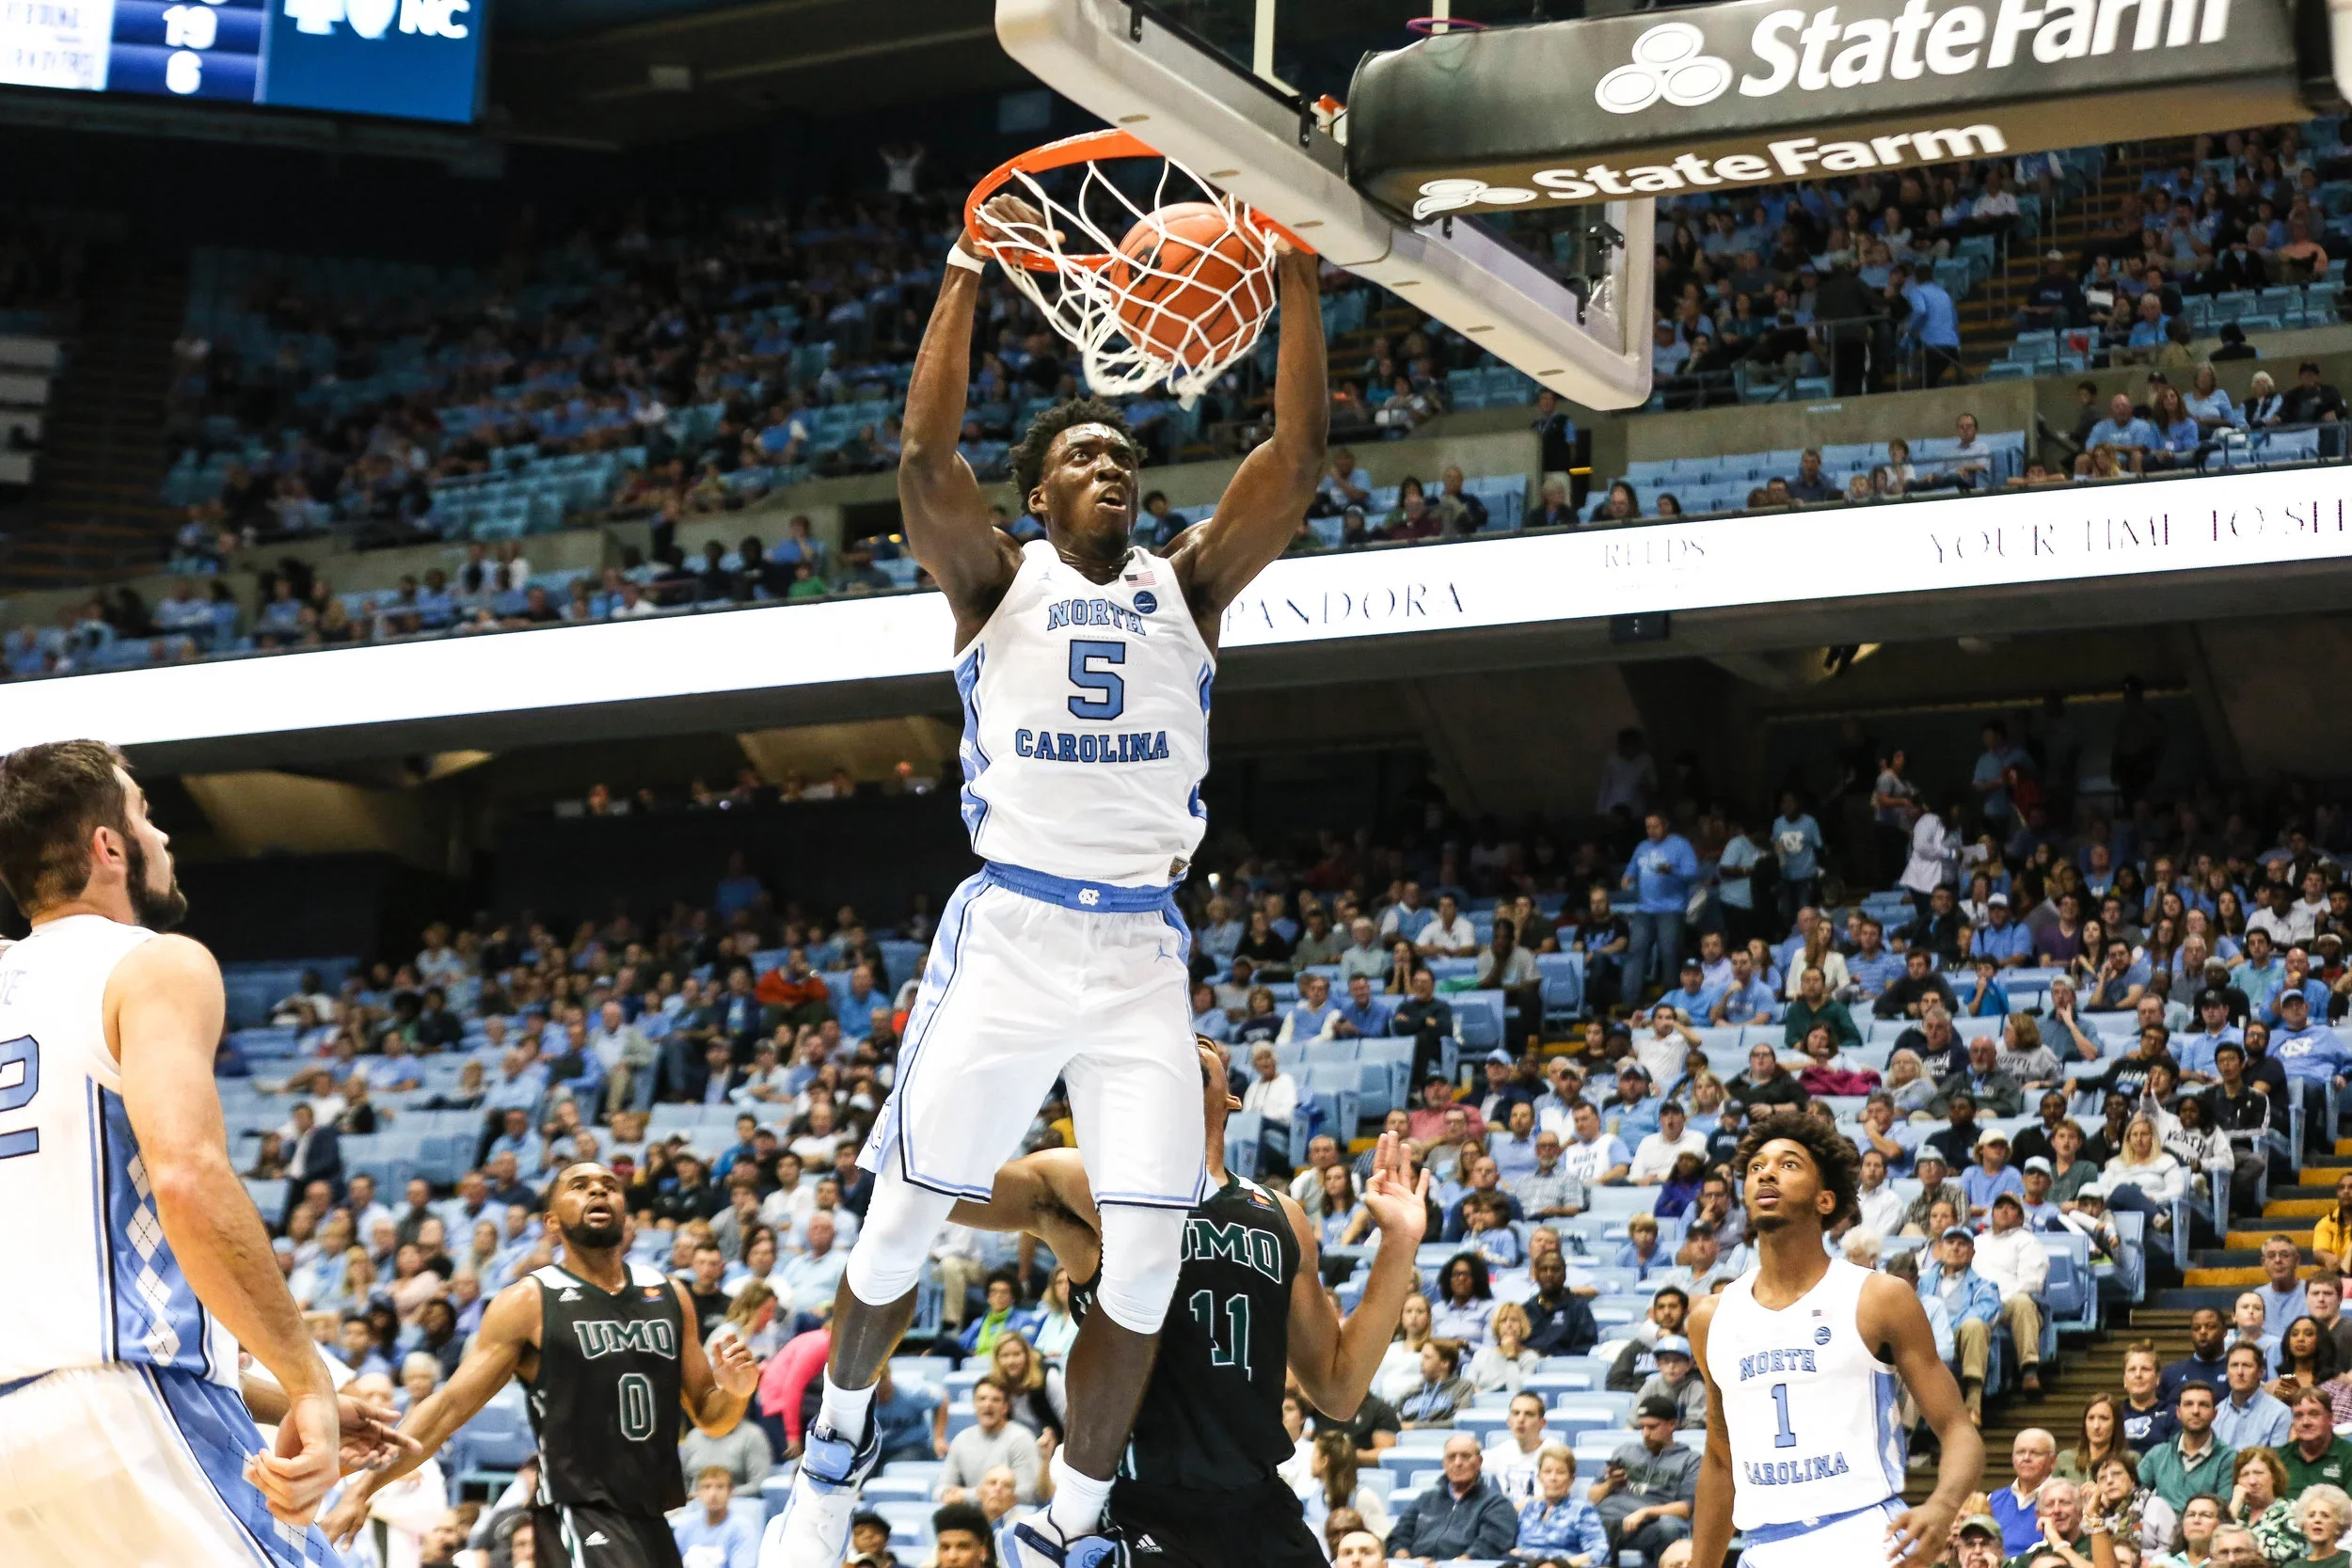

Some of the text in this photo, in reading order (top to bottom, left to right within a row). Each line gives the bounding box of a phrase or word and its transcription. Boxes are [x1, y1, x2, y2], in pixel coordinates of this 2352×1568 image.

[162, 3, 218, 50] 19
[165, 49, 203, 95] 6
[1931, 522, 2055, 563] YOUR
[1046, 598, 1147, 637] NORTH
[1226, 581, 1464, 633] PANDORA
[1068, 639, 1127, 721] 5
[1014, 728, 1170, 764] CAROLINA
[572, 1317, 677, 1360] UMO
[1189, 1289, 1253, 1382] 11
[1739, 1348, 1818, 1382] NORTH
[617, 1371, 657, 1442] 0
[1771, 1383, 1797, 1449] 1
